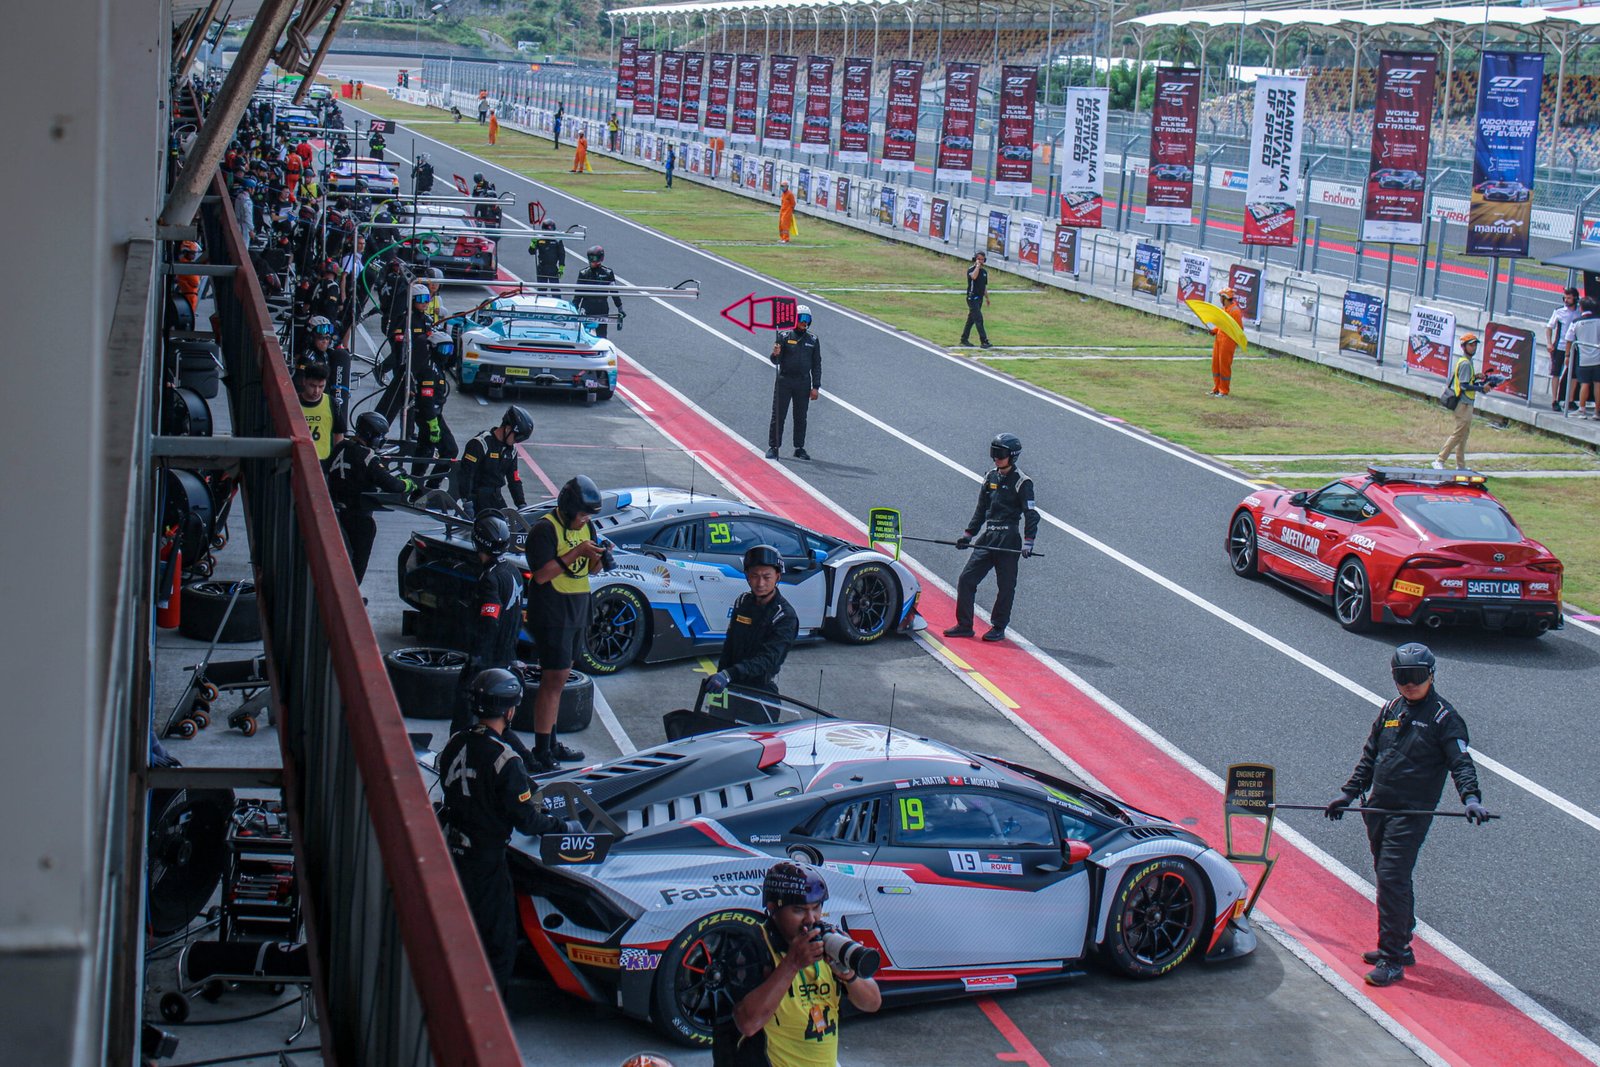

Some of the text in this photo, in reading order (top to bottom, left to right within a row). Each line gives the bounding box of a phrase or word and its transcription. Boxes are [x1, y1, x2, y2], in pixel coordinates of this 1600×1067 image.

[1386, 68, 1427, 79] GT
[1161, 82, 1194, 91] GT
[1489, 76, 1534, 87] GT
[370, 120, 386, 131] 75
[1073, 97, 1084, 162] OF SPEED
[1262, 88, 1277, 166] OF SPEED
[1271, 89, 1287, 169] FESTIVAL
[1480, 118, 1536, 127] INDONESIA'S
[1081, 97, 1092, 164] FESTIVAL
[1088, 98, 1100, 183] MANDALIKA
[1279, 90, 1296, 192] MANDALIKA
[1322, 191, 1356, 206] Enduro
[1474, 224, 1513, 234] mandiri
[1058, 231, 1073, 243] GT
[1233, 270, 1256, 285] GT
[1417, 311, 1448, 324] MANDALIKA
[1420, 319, 1444, 330] FESTIVAL
[1425, 327, 1441, 336] SPEED
[1492, 331, 1526, 350] GT
[1500, 362, 1513, 374] aws
[708, 523, 731, 543] 29
[1281, 526, 1306, 550] SAFETY
[1304, 534, 1320, 555] CAR
[1467, 582, 1520, 594] SAFETY CAR
[1237, 780, 1257, 788] DRIVER
[899, 797, 925, 831] 19
[560, 836, 595, 851] aws
[957, 853, 976, 870] 19
[990, 863, 1012, 871] ROWE
[712, 868, 767, 883] PERTAMIN
[1129, 862, 1160, 891] ZERO
[660, 882, 763, 905] Fastro
[1161, 937, 1196, 974] PIRELLI
[798, 983, 830, 999] SRO
